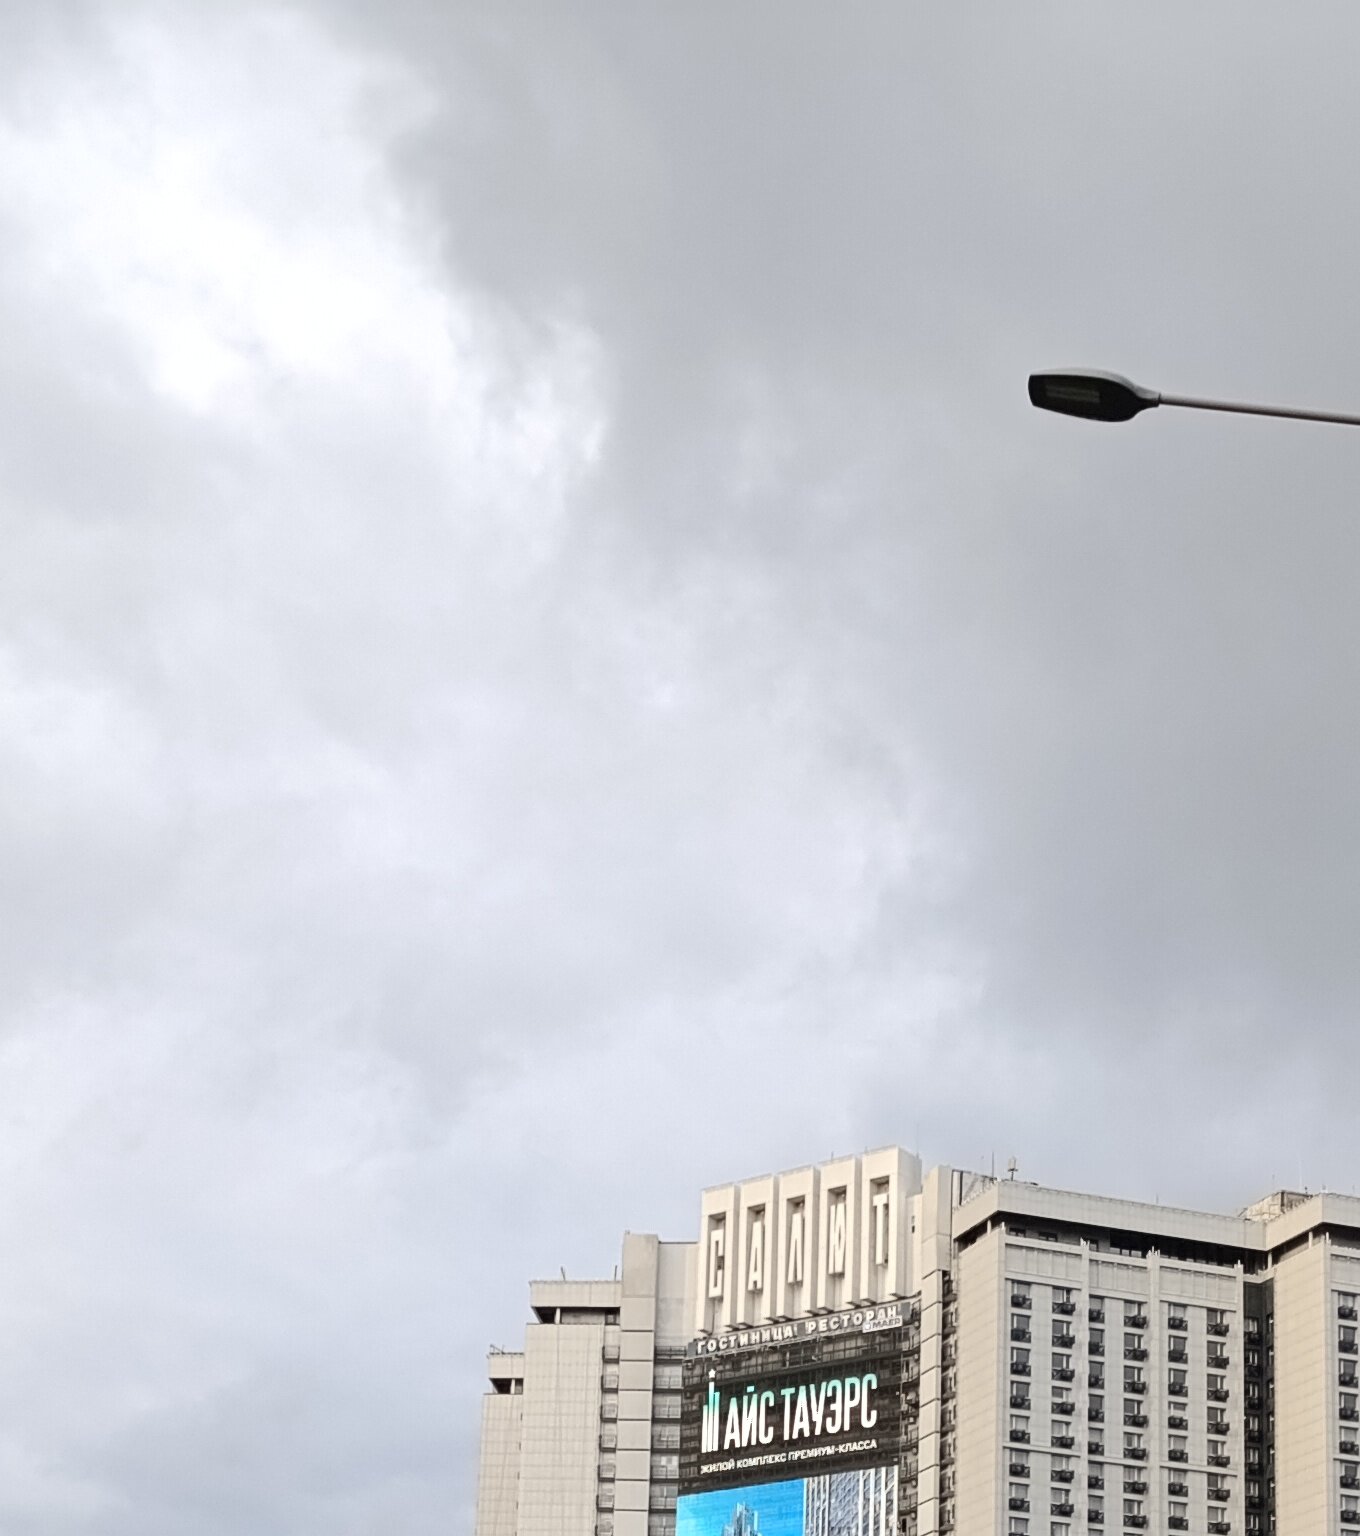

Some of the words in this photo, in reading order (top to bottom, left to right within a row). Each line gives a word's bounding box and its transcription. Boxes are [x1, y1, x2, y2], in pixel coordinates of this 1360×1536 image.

[697, 1328, 793, 1355] ГОСТИНИЦА
[807, 1306, 897, 1334] РЕСТОРАН
[723, 1385, 775, 1450] АЙС
[781, 1373, 878, 1441] ТАУЭРС
[700, 1458, 735, 1475] ЖИЛОЙ
[736, 1452, 786, 1470] КОМПЛЕКС
[788, 1439, 877, 1461] ПРЕМИУМ-КЛАССА
